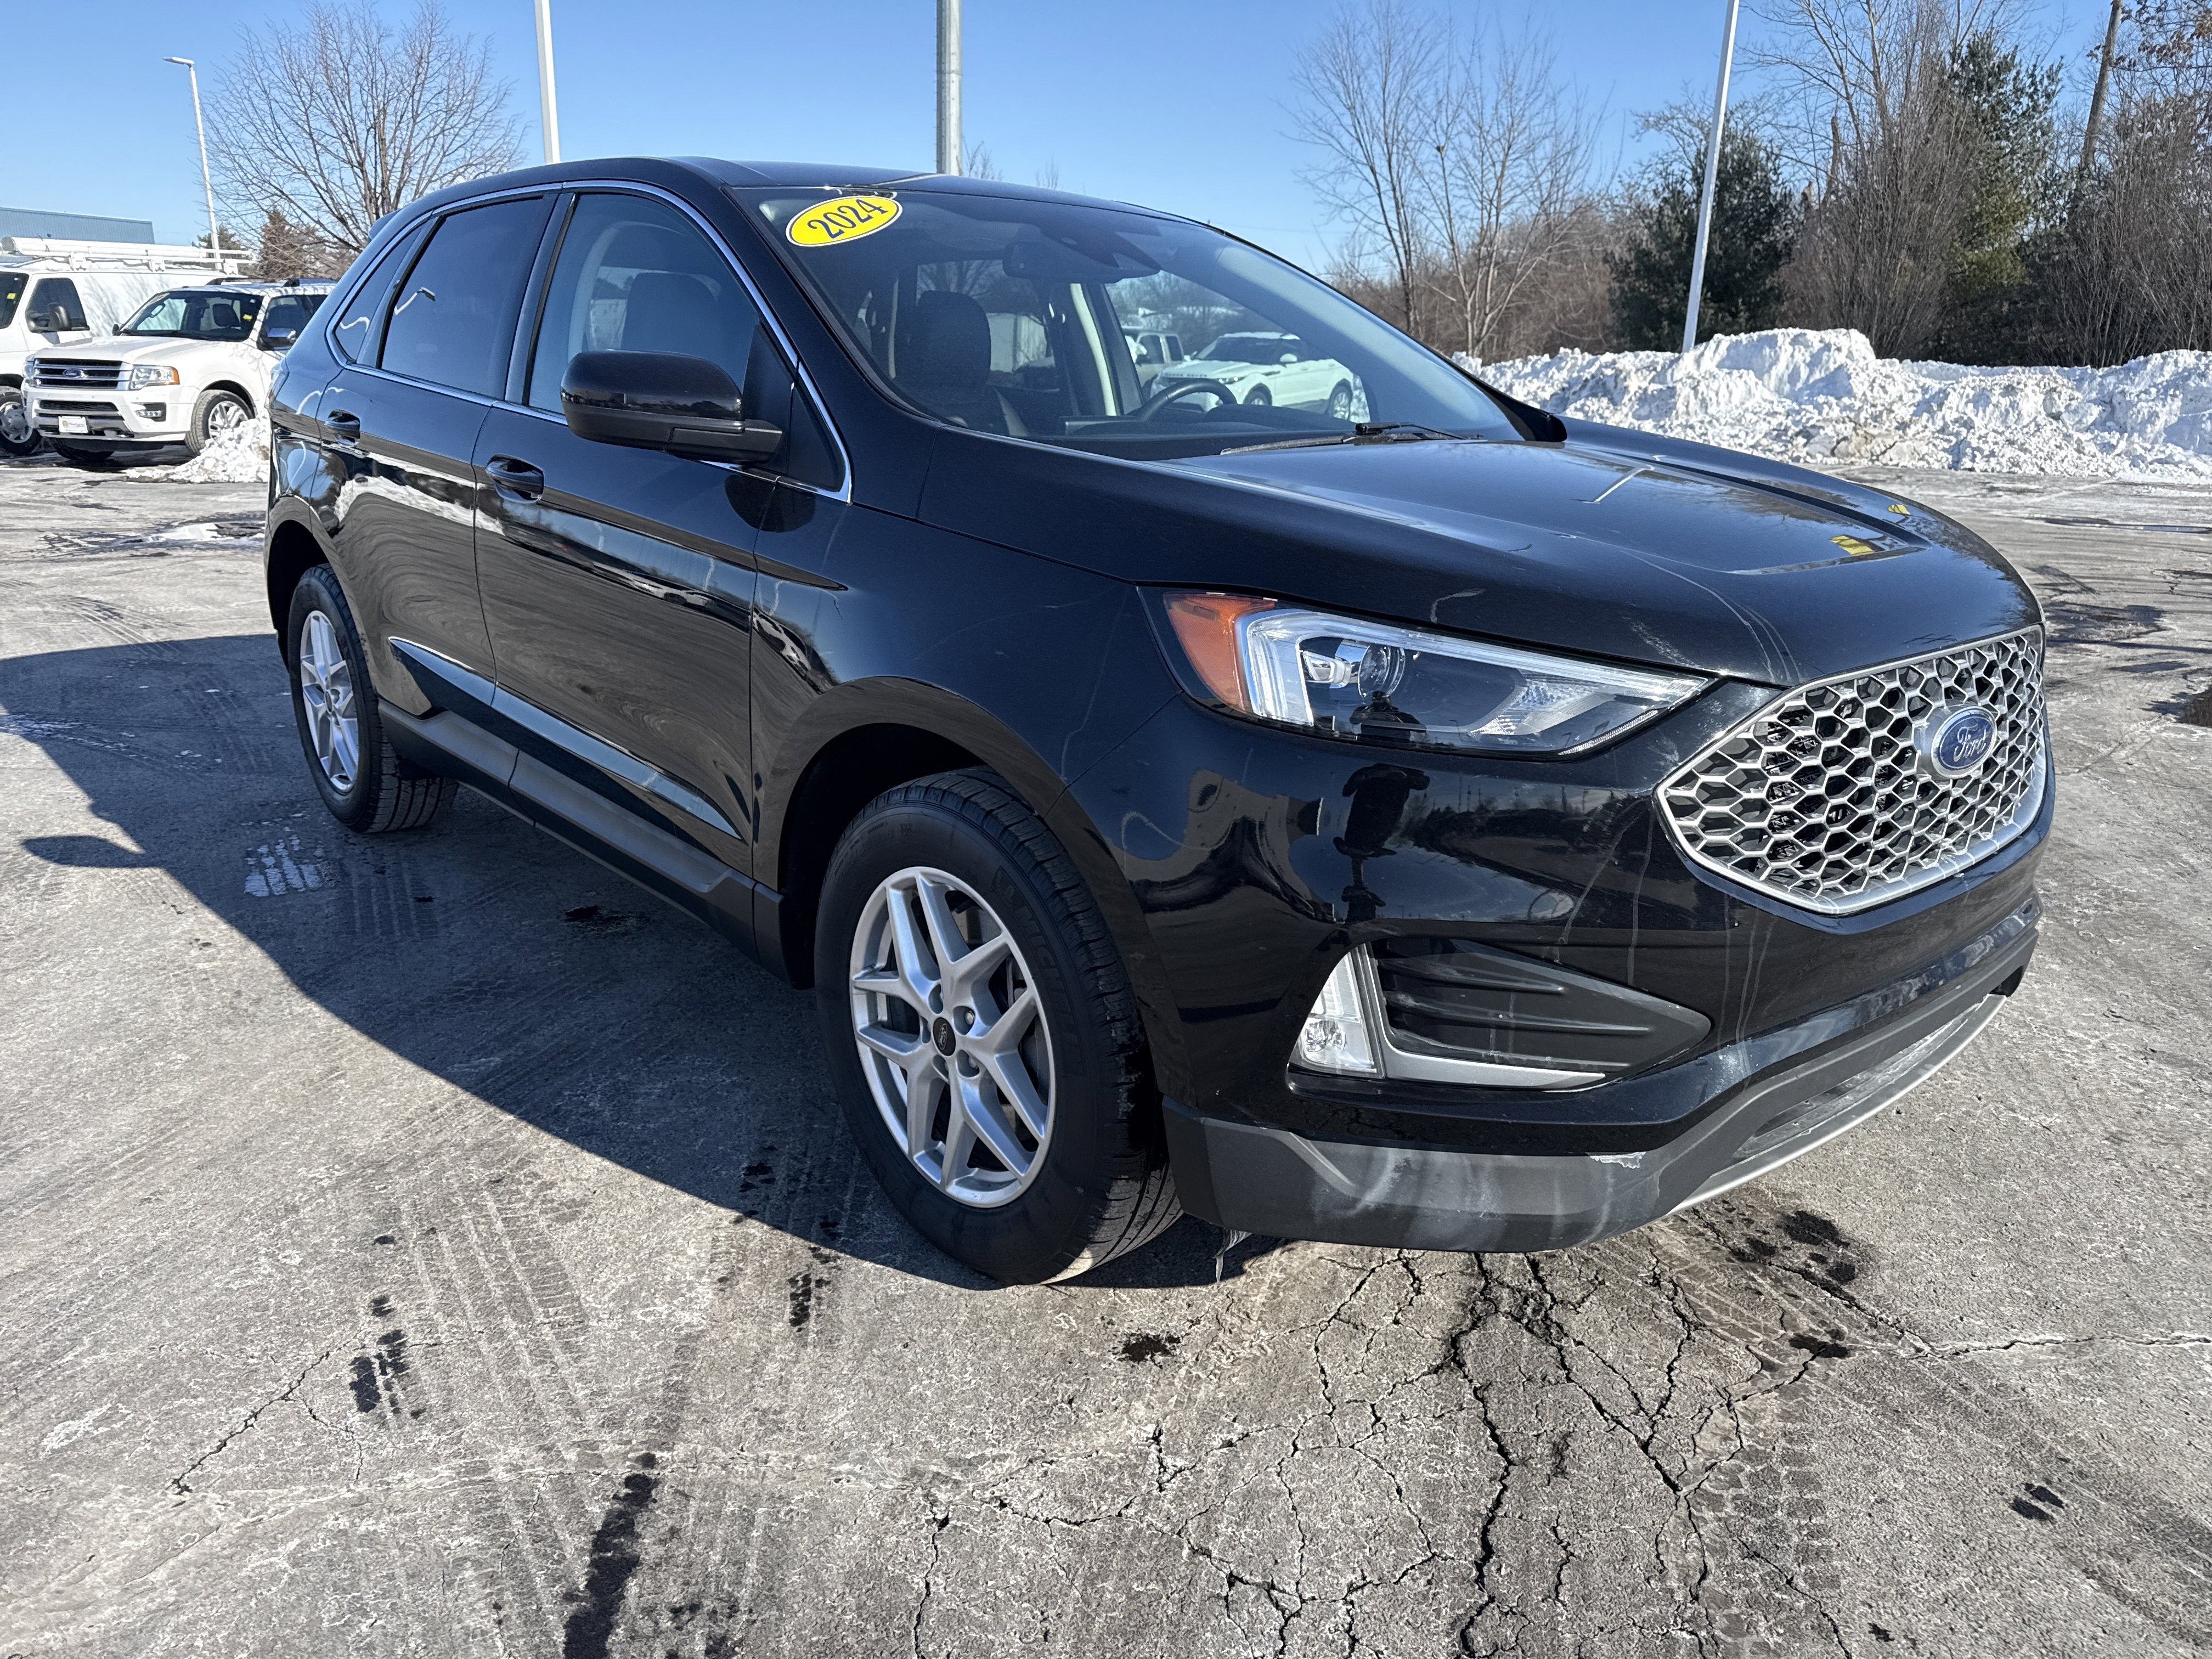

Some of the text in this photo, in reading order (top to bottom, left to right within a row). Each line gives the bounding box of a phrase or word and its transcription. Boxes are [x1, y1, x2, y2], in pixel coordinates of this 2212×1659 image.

[807, 199, 889, 239] 2024
[1953, 723, 1987, 763] Ford
[1014, 906, 1084, 1075] MICHELIN
